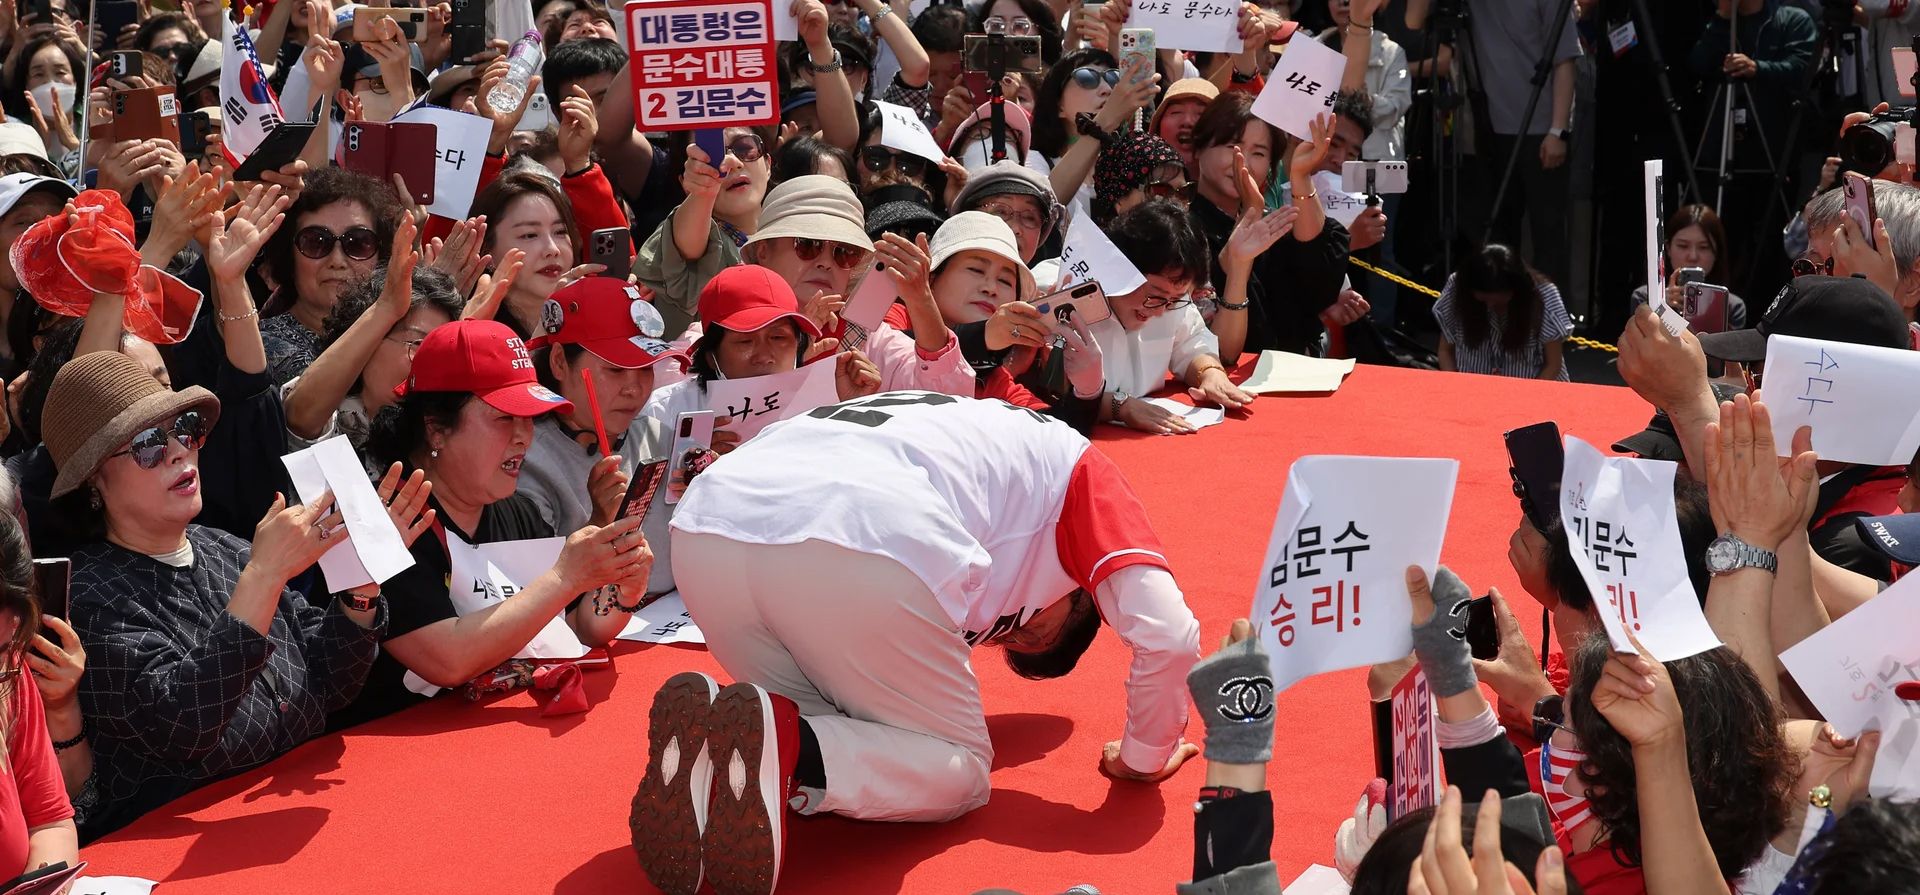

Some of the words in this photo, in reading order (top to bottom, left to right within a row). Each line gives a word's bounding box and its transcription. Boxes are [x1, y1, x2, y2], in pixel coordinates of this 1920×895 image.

[1138, 0, 1171, 15] 나도
[1184, 1, 1232, 19] 문수다
[640, 10, 762, 44] 대통령은
[642, 48, 766, 84] 문수대통
[1286, 72, 1322, 95] 나도
[647, 92, 667, 119] 2
[676, 87, 766, 119] 김문수
[1797, 347, 1840, 415] 수다
[727, 390, 780, 423] 나도
[1870, 521, 1900, 548] SWAT
[1311, 580, 1362, 633] 리!
